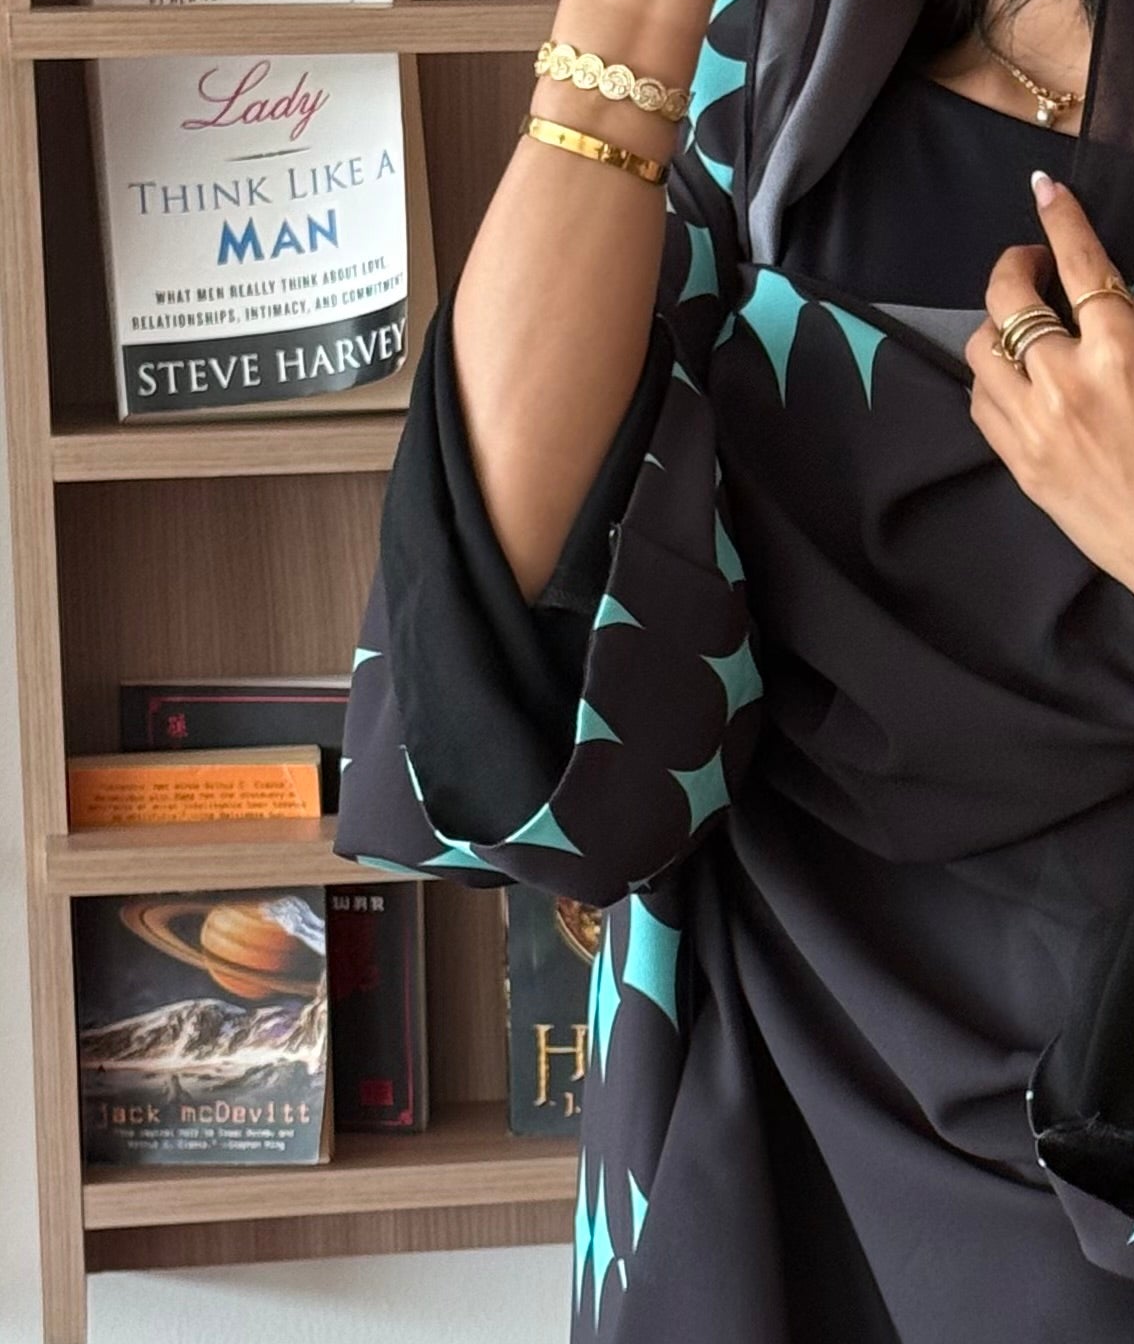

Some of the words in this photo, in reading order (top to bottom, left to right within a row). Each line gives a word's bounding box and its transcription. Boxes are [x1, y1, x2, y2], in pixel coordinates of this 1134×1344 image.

[180, 59, 332, 143] Lady
[128, 174, 271, 216] THINK
[287, 155, 364, 203] LIKE
[375, 149, 397, 180] A
[216, 208, 340, 267] MAN
[132, 311, 242, 331] RELATIONSHIPS,
[245, 300, 311, 322] INTIMACY,
[315, 293, 338, 310] AND
[154, 288, 192, 305] WHAT
[197, 286, 225, 301] MEN
[230, 280, 276, 299] REALLY
[281, 272, 319, 292] THINK
[322, 264, 358, 286] ABOUT
[137, 353, 262, 397] STEVE
[275, 318, 408, 384] HARVEY
